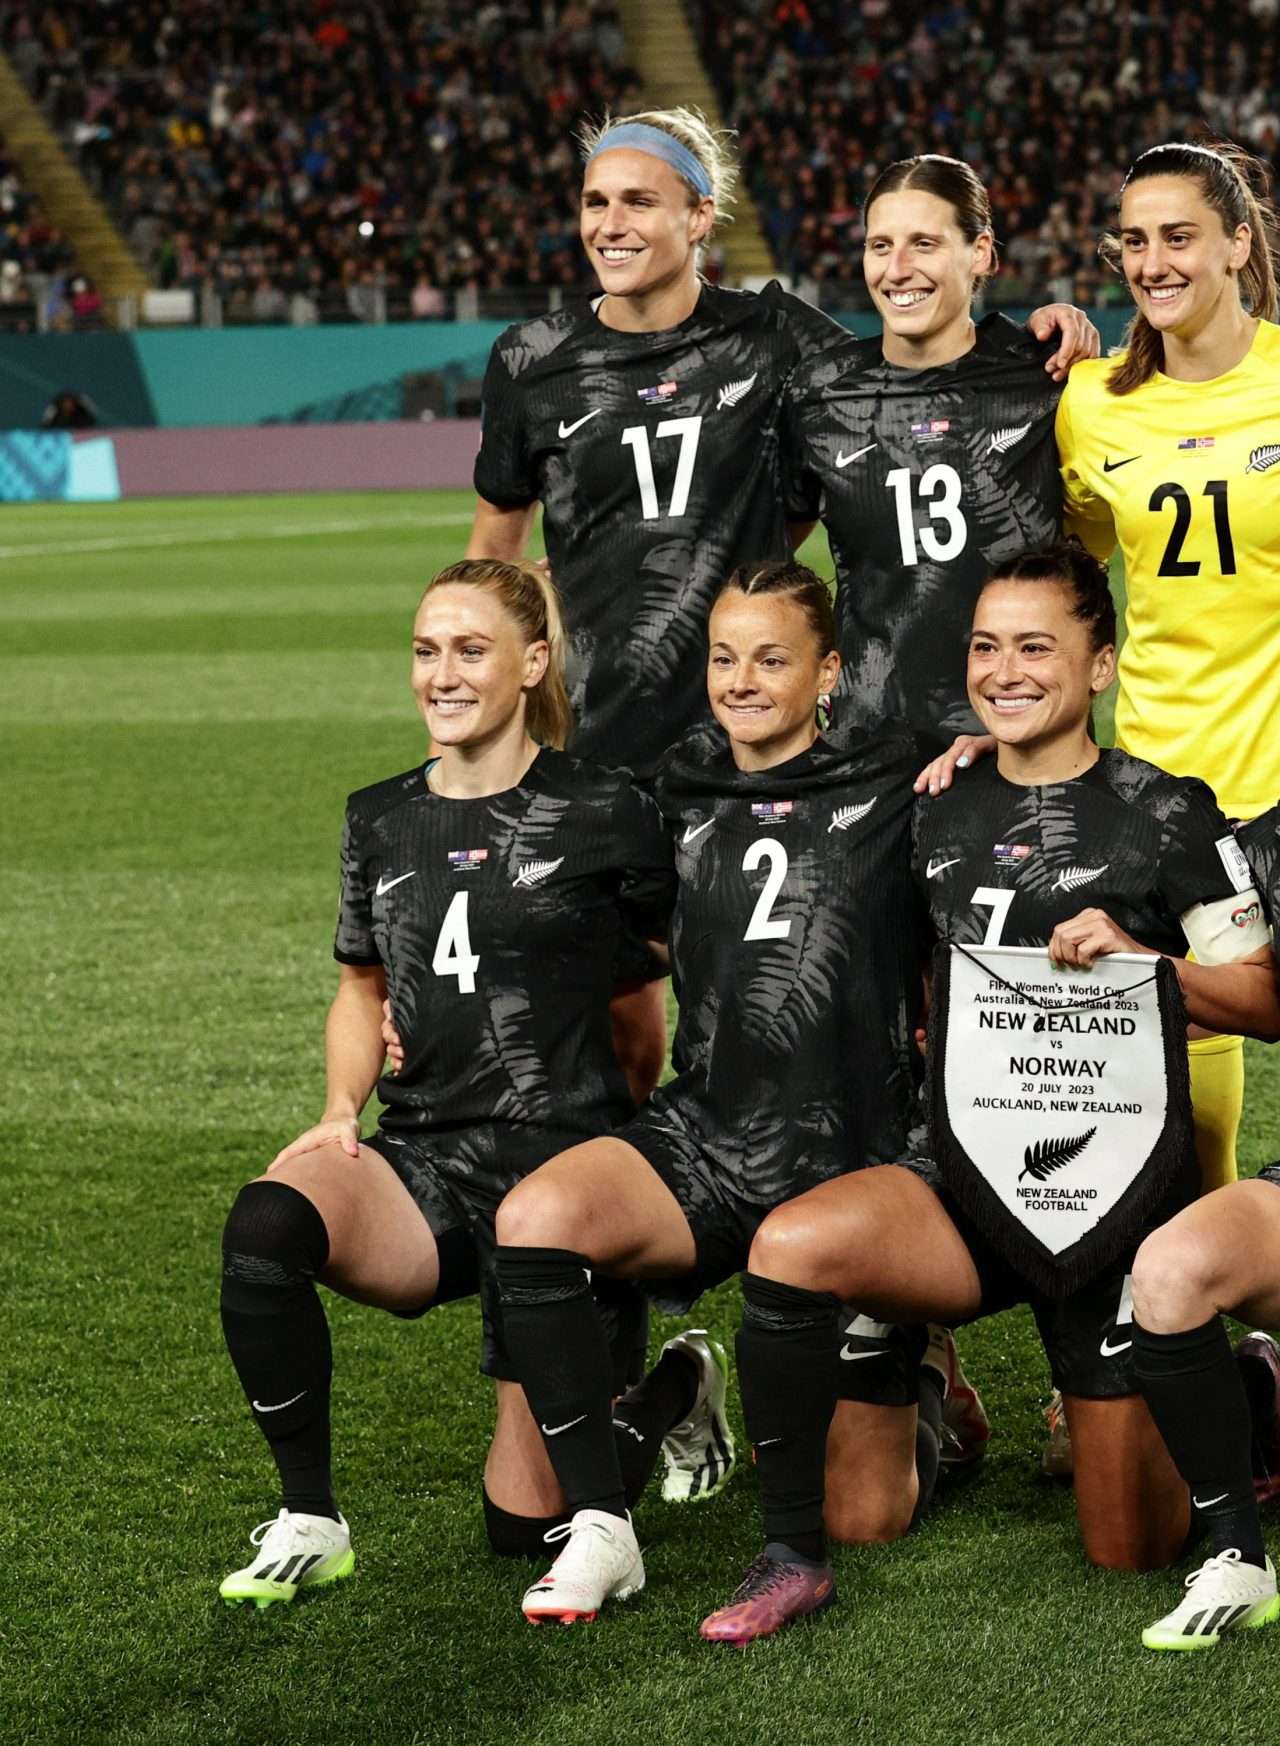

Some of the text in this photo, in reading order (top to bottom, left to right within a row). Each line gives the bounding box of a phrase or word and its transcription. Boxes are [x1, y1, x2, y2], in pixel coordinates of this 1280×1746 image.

[621, 416, 702, 519] 17
[884, 464, 967, 565] 13
[1149, 481, 1235, 576] 21
[743, 838, 791, 942] 2
[970, 887, 1016, 945] 7
[432, 891, 480, 993] 4
[989, 980, 1125, 1000] FIFA Women's World Cup
[974, 993, 1025, 1005] Australia
[1040, 996, 1062, 1007] New
[1114, 1001, 1139, 1011] 2023
[979, 1010, 1026, 1030] NEW
[1009, 1056, 1107, 1078] NORWAY
[1021, 1082, 1095, 1095] 20 JULY 2023
[972, 1097, 1142, 1114] AUCKLAND, NEW ZEALAND
[1016, 1187, 1098, 1199] NEW ZEALAND
[1025, 1200, 1088, 1211] FOOTBALL
